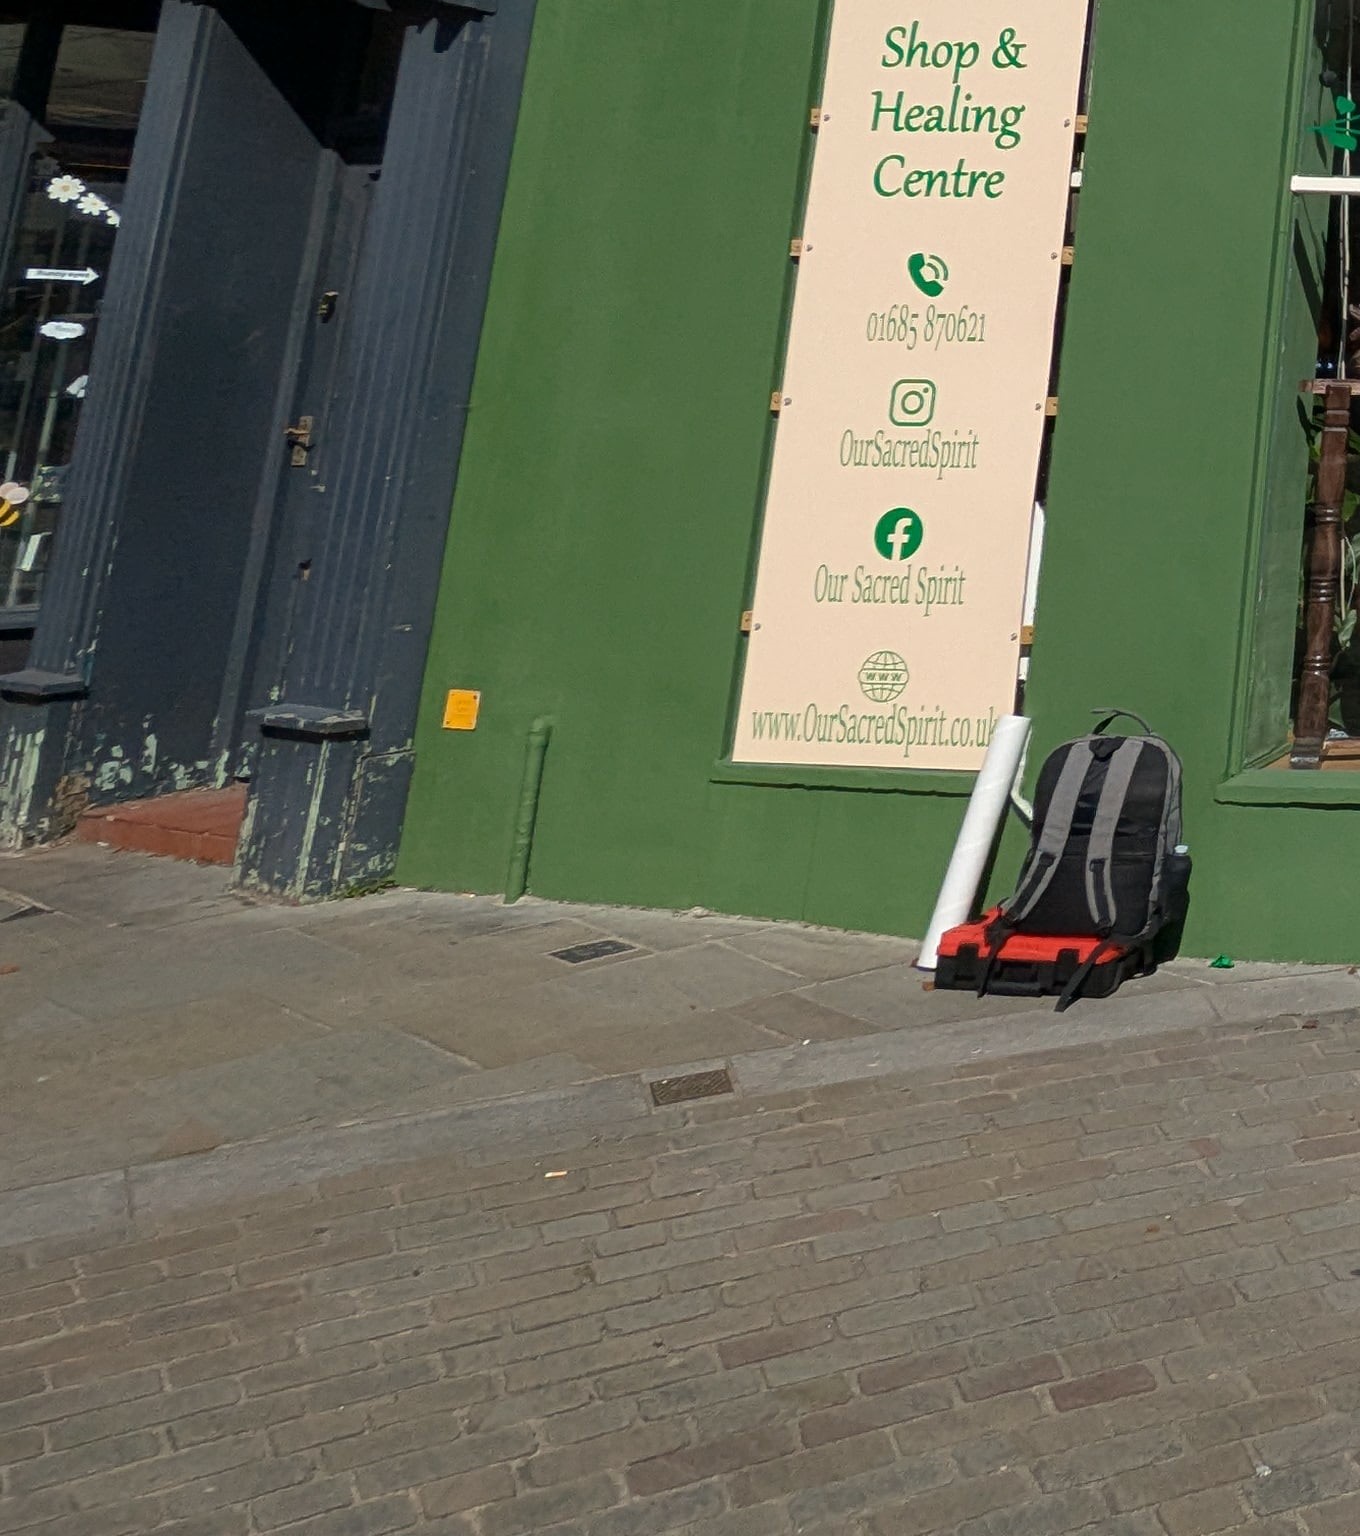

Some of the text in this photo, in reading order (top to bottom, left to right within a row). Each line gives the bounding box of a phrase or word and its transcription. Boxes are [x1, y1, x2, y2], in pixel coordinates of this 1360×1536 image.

[881, 20, 1028, 84] Shop &
[870, 84, 1026, 150] Healing
[872, 155, 1006, 198] Centre
[866, 304, 986, 351] 01685 870621
[839, 429, 979, 480] OurSacredSpirit
[814, 564, 967, 617] Our Sacred Spirit
[751, 703, 999, 758] www.OurSacredSpirit.co.uk
